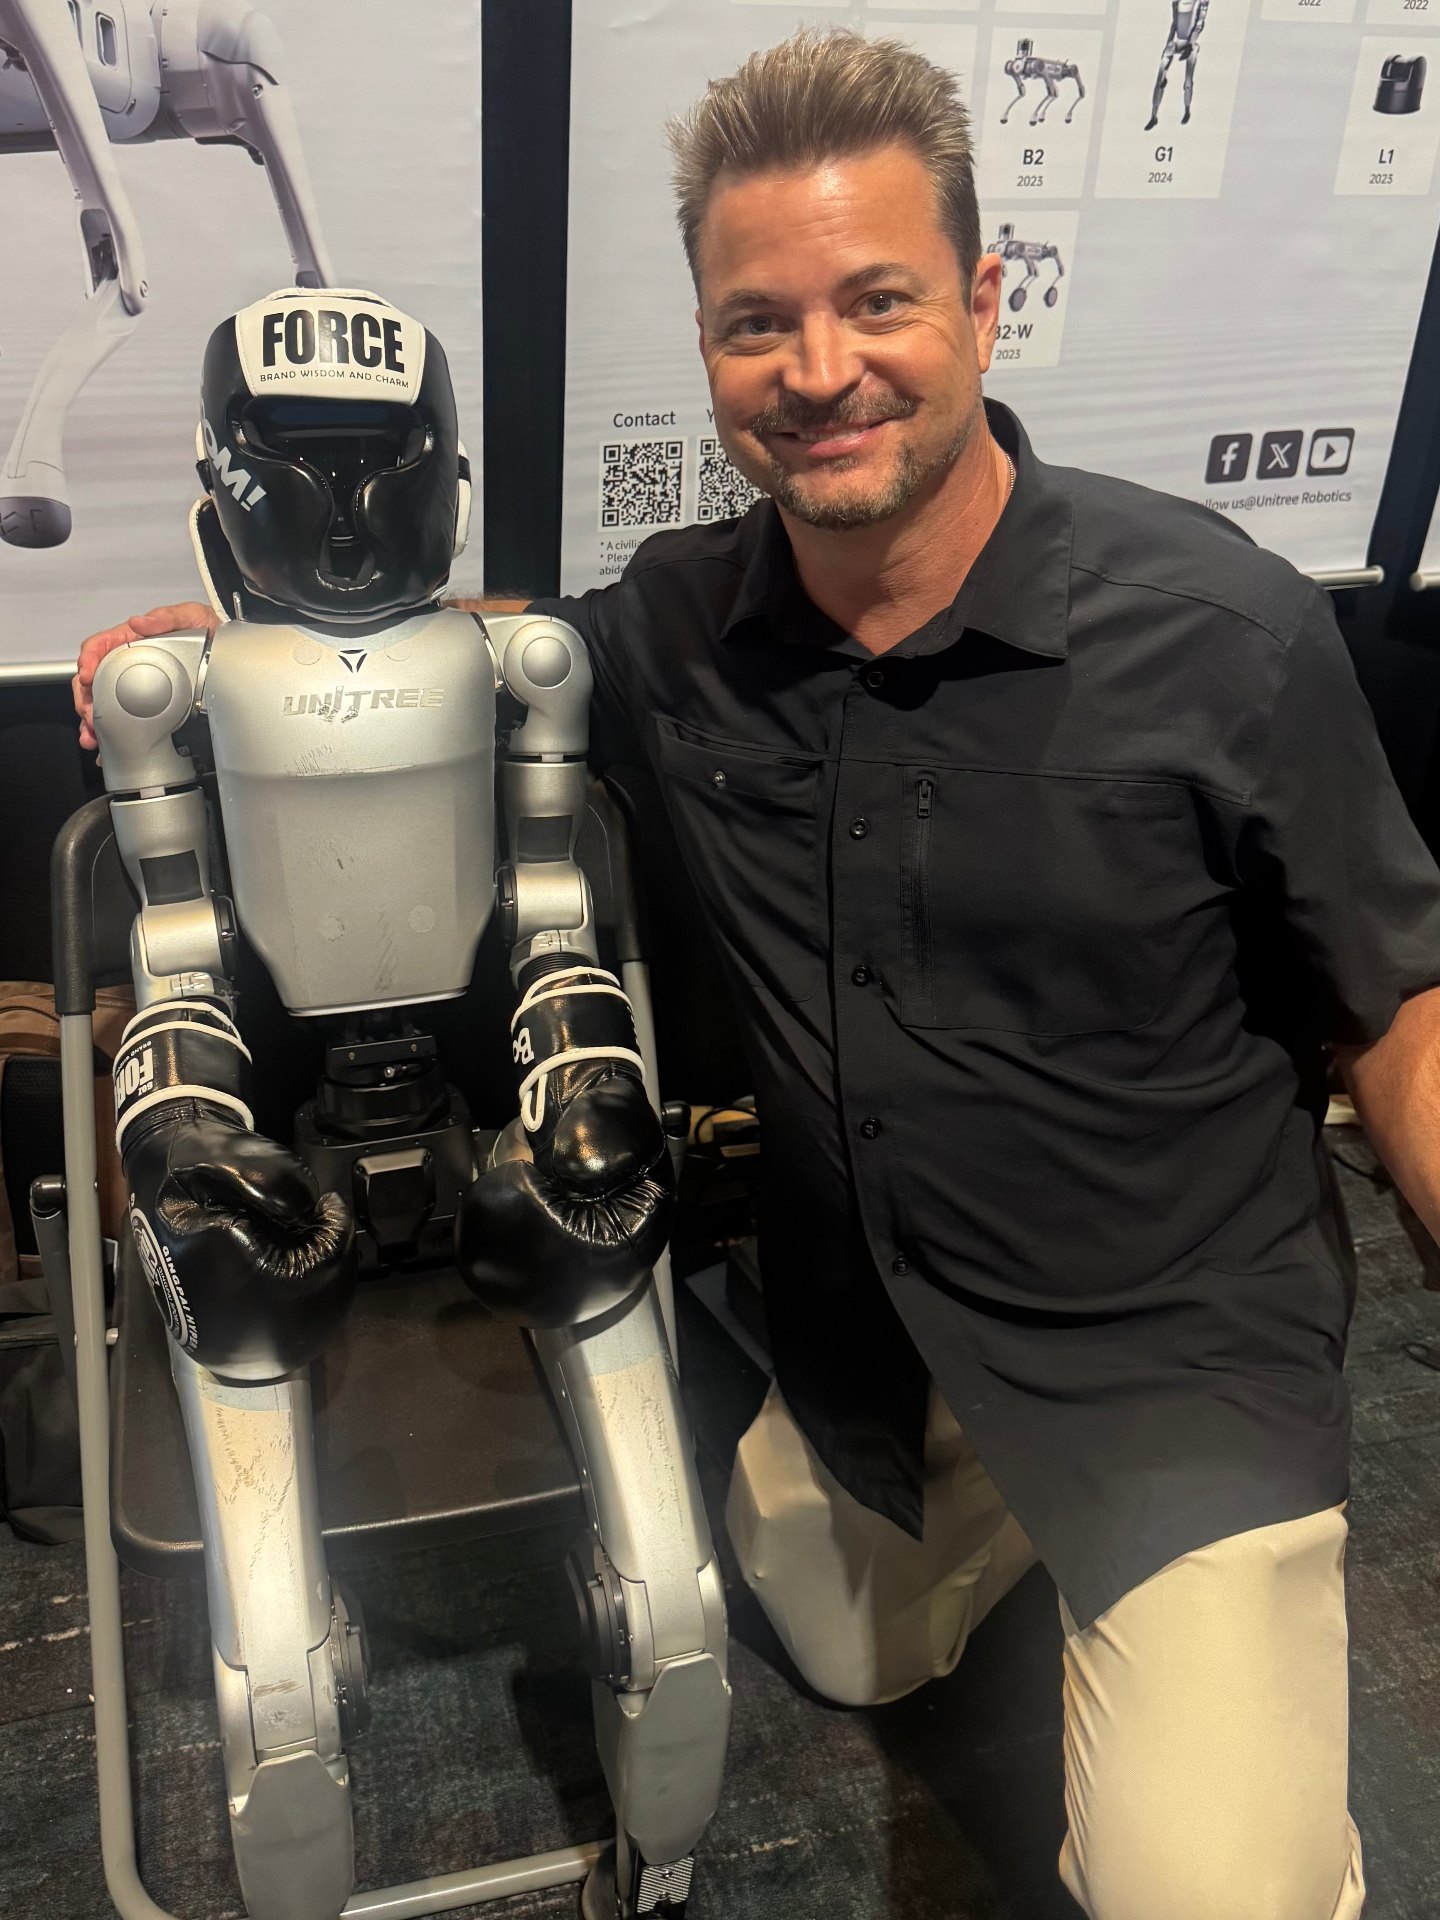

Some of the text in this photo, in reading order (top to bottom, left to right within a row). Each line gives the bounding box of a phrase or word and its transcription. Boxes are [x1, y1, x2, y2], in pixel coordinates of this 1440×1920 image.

[1403, 0, 1429, 10] 2022
[1022, 149, 1045, 165] B2
[1154, 146, 1174, 162] G1
[1378, 149, 1395, 165] L1
[1016, 175, 1043, 187] 2023
[1147, 172, 1173, 184] 2024
[1369, 173, 1394, 185] 2023
[262, 309, 405, 374] FORCE
[995, 349, 1021, 361] 2023
[260, 369, 409, 388] BRAND WISDOM AND CHARM
[613, 411, 677, 428] Contact
[202, 418, 267, 512] OM!
[1205, 498, 1229, 511] llow
[1301, 489, 1352, 505] Robotics
[606, 539, 642, 551] A civili
[607, 553, 633, 563] Plea
[115, 1047, 154, 1110] FOR
[162, 1245, 191, 1313] QINGPAI
